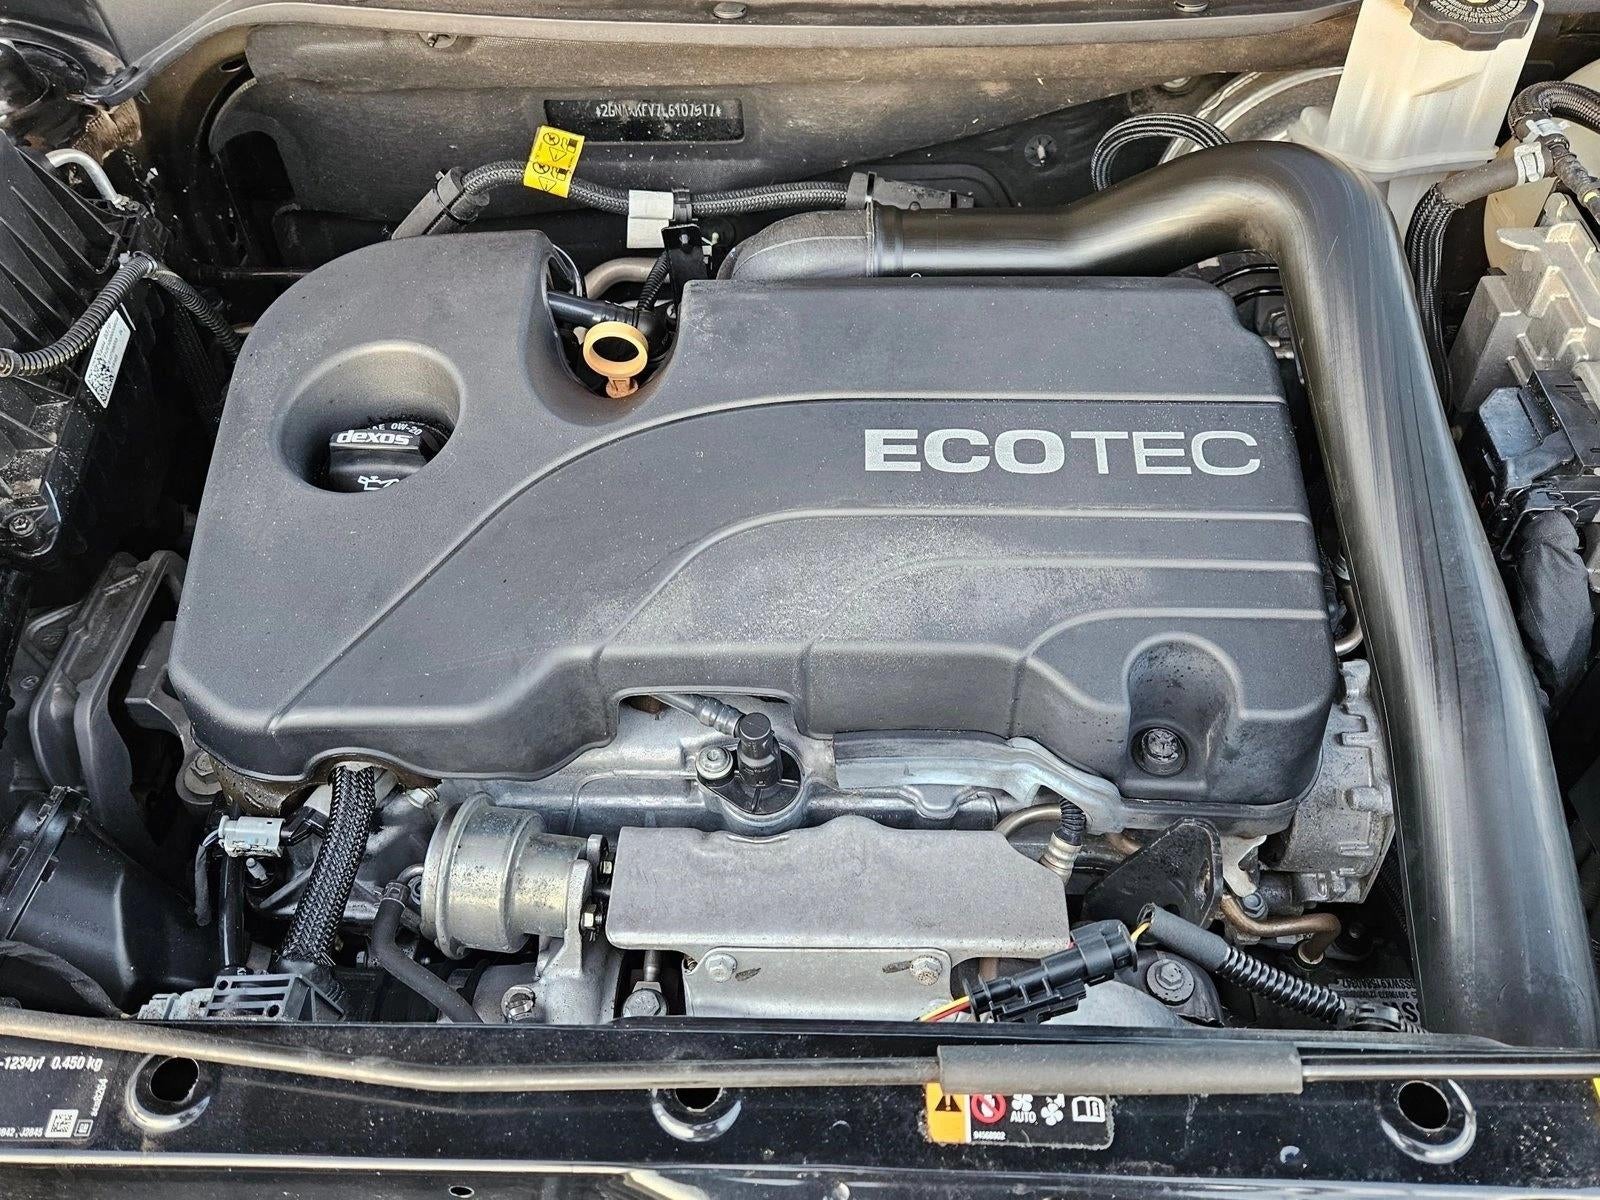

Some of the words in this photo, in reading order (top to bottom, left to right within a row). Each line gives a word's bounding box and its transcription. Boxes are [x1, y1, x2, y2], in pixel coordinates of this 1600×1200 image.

[1459, 15, 1478, 23] FROM
[391, 422, 422, 435] 0W-20
[337, 430, 410, 445] dexos
[865, 428, 1261, 475] ECOTEC
[51, 1056, 86, 1070] 0.450
[86, 1056, 103, 1072] kg
[1010, 1111, 1036, 1124] AUTO
